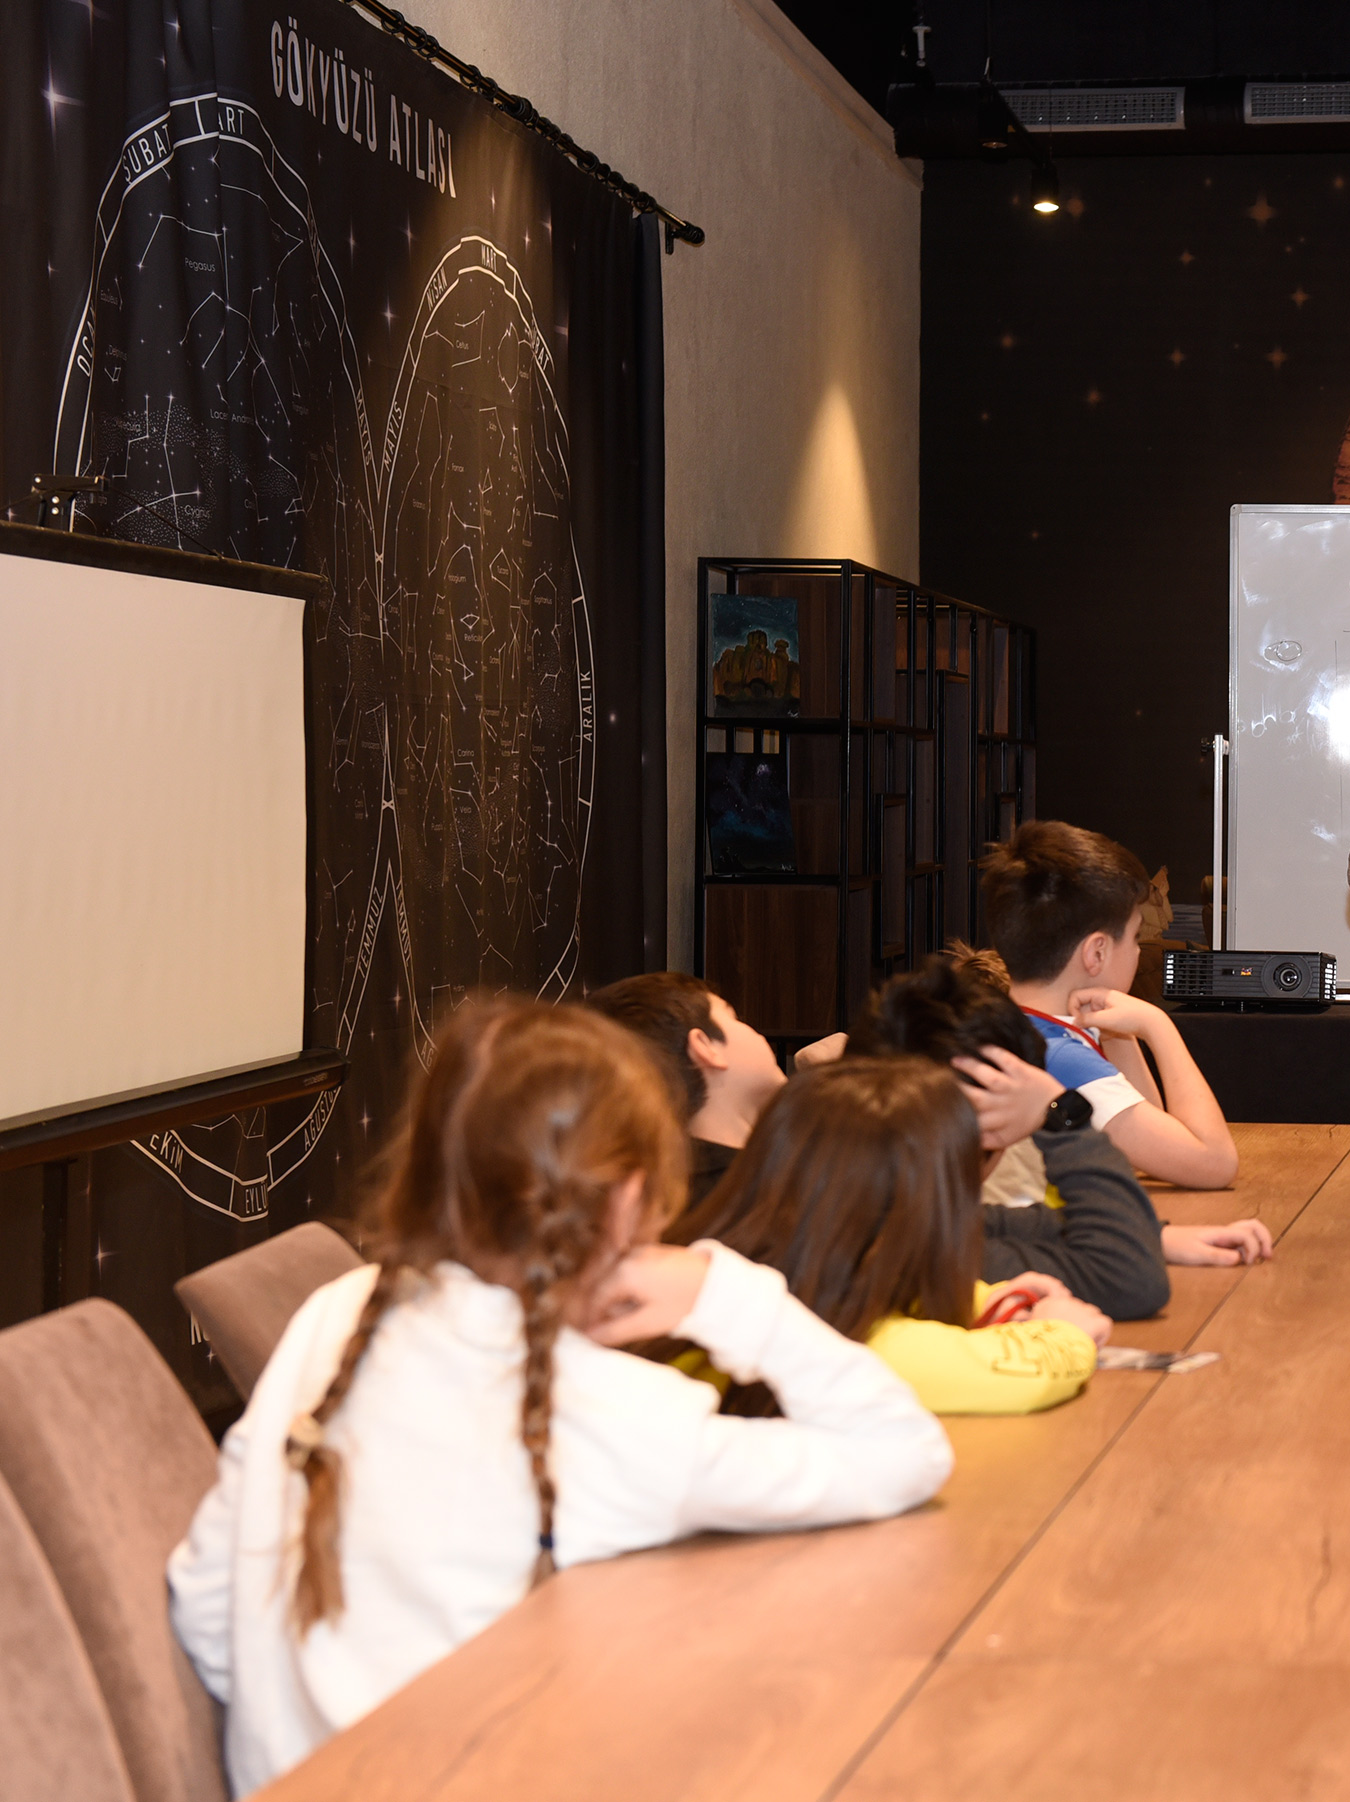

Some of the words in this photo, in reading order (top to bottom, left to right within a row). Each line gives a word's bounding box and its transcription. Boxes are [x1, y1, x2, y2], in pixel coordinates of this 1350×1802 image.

[270, 16, 378, 153] GÖKYÜZÜ
[389, 93, 457, 199] ATLASI
[184, 257, 216, 273] Pegasus
[383, 400, 403, 473] MAYIS
[580, 670, 593, 743] ARALIK
[357, 886, 385, 980] TEMMUZ
